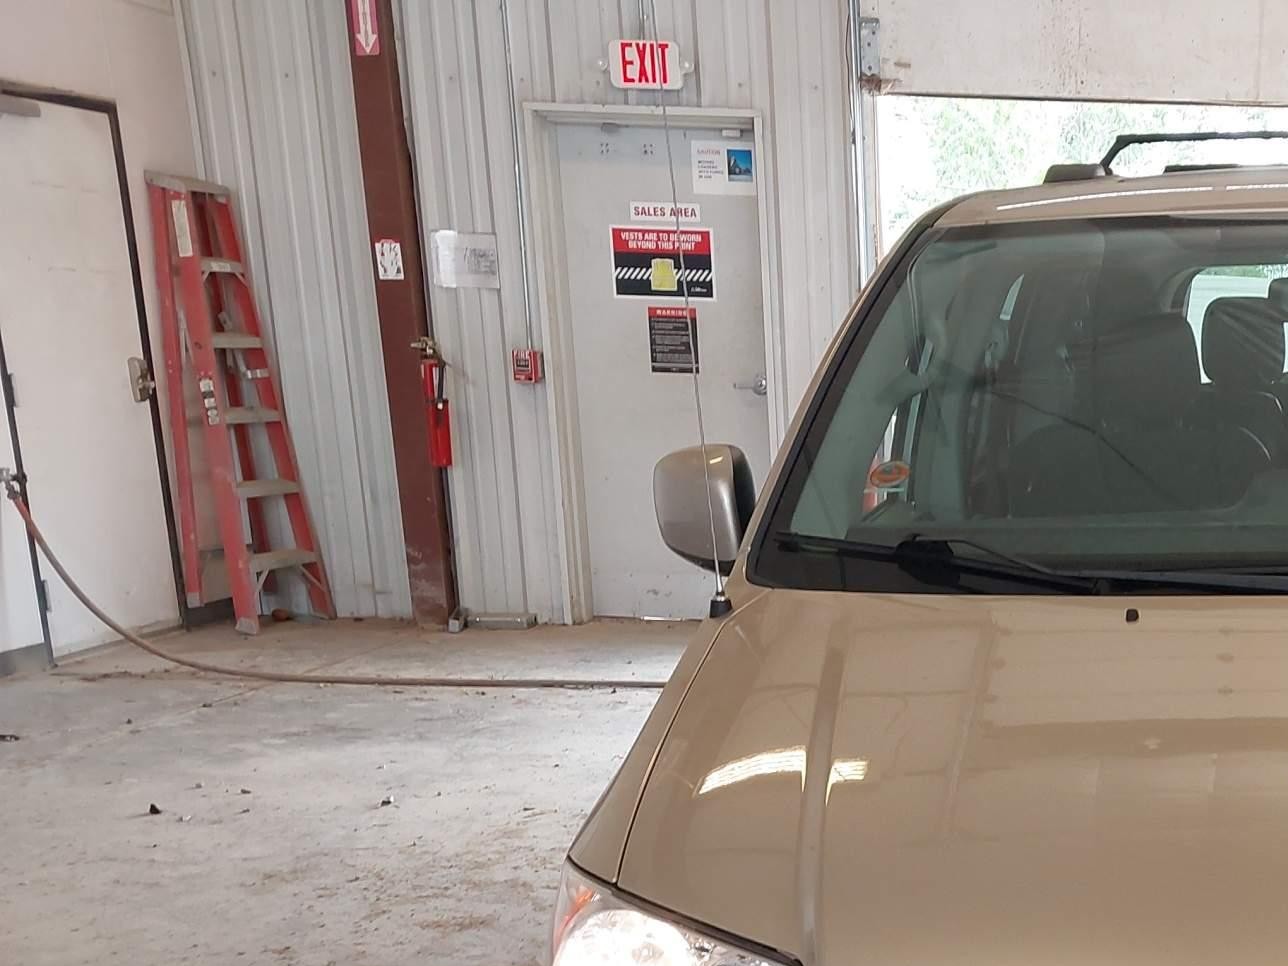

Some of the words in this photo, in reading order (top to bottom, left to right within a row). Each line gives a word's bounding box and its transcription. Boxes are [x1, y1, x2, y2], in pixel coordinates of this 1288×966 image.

[620, 42, 669, 84] EXIT
[634, 206, 666, 217] SALES
[669, 207, 697, 218] AREA
[621, 231, 643, 240] VESTS
[644, 232, 658, 241] ARE
[659, 232, 668, 241] TO
[680, 233, 702, 242] WORN
[628, 240, 656, 249] BEYOND
[658, 241, 674, 250] THIS
[656, 309, 688, 317] WARNING
